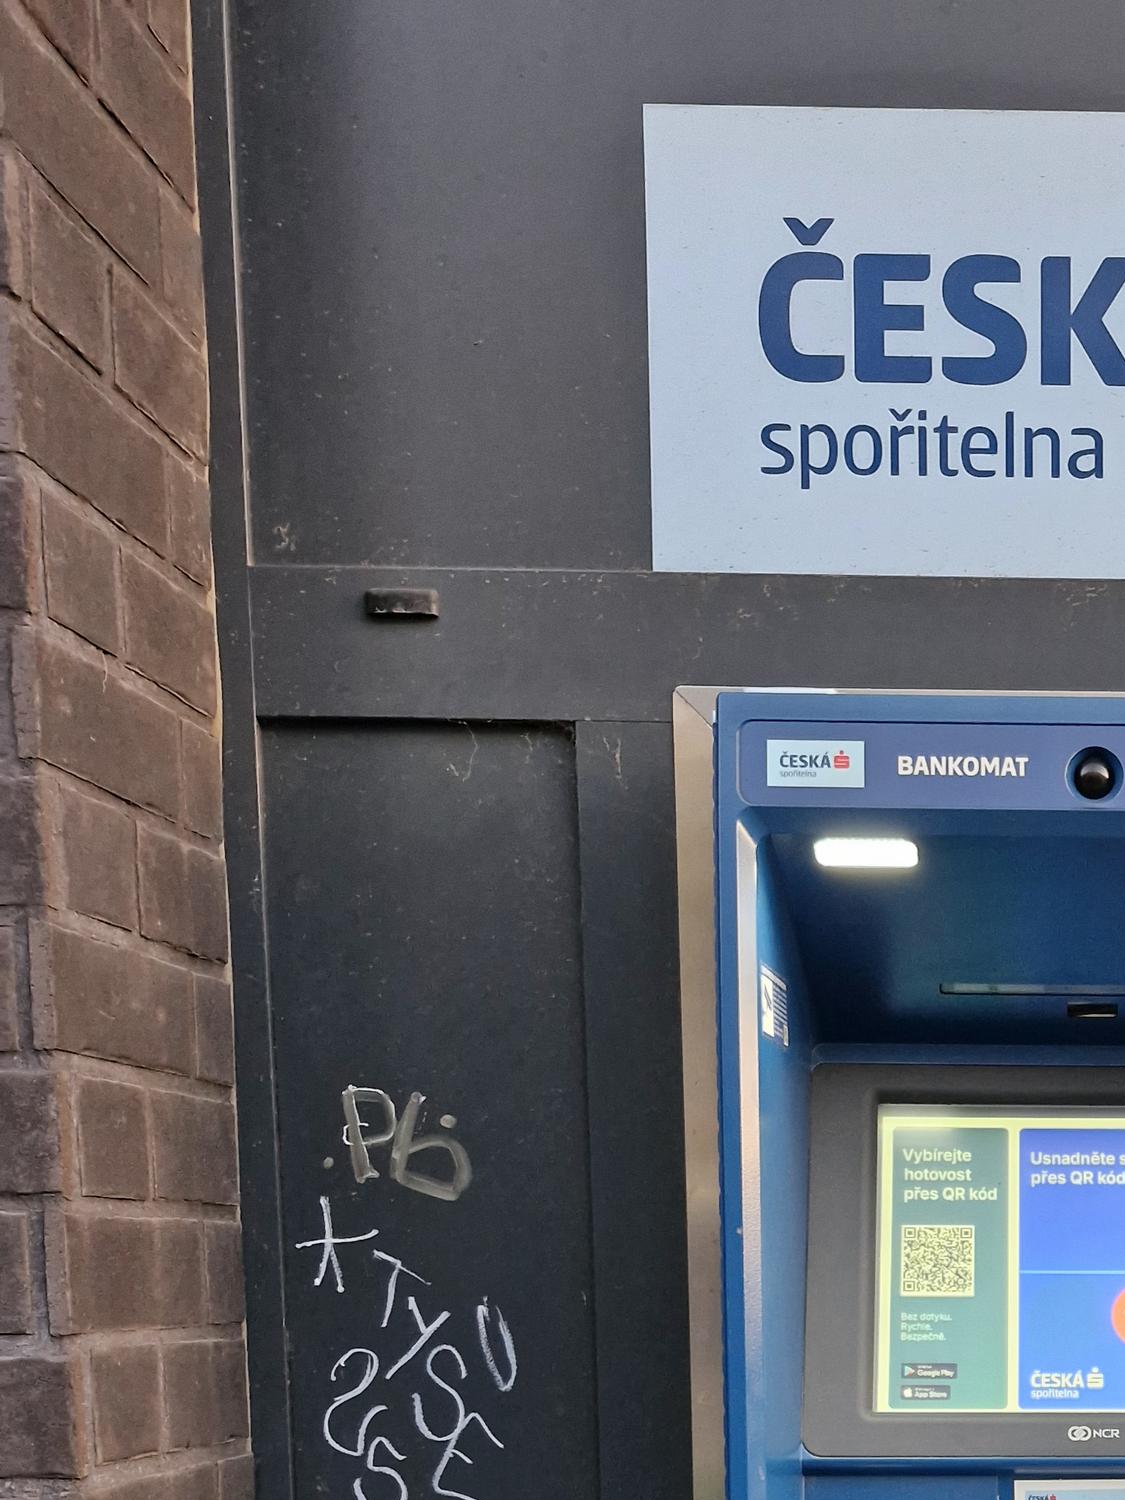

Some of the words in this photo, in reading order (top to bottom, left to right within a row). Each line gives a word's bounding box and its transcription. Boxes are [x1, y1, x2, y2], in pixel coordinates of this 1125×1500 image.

[758, 407, 1105, 489] spořitelna
[779, 751, 832, 769] ČESKÁ
[897, 755, 1029, 777] BANKOMAT
[902, 1148, 972, 1165] Vybírejte
[1030, 1151, 1116, 1166] Usnadněte
[904, 1168, 972, 1181] hotovost
[1030, 1170, 1067, 1187] přes
[1070, 1171, 1094, 1186] QR
[904, 1186, 939, 1203] přes
[942, 1187, 966, 1201] QR
[969, 1186, 998, 1201] kód
[900, 1312, 918, 1321] Bez
[919, 1312, 953, 1322] dotyku.
[1031, 1370, 1085, 1389] ČESKÁ
[1031, 1388, 1080, 1400] spořitelna
[1092, 1428, 1120, 1439] NCR
